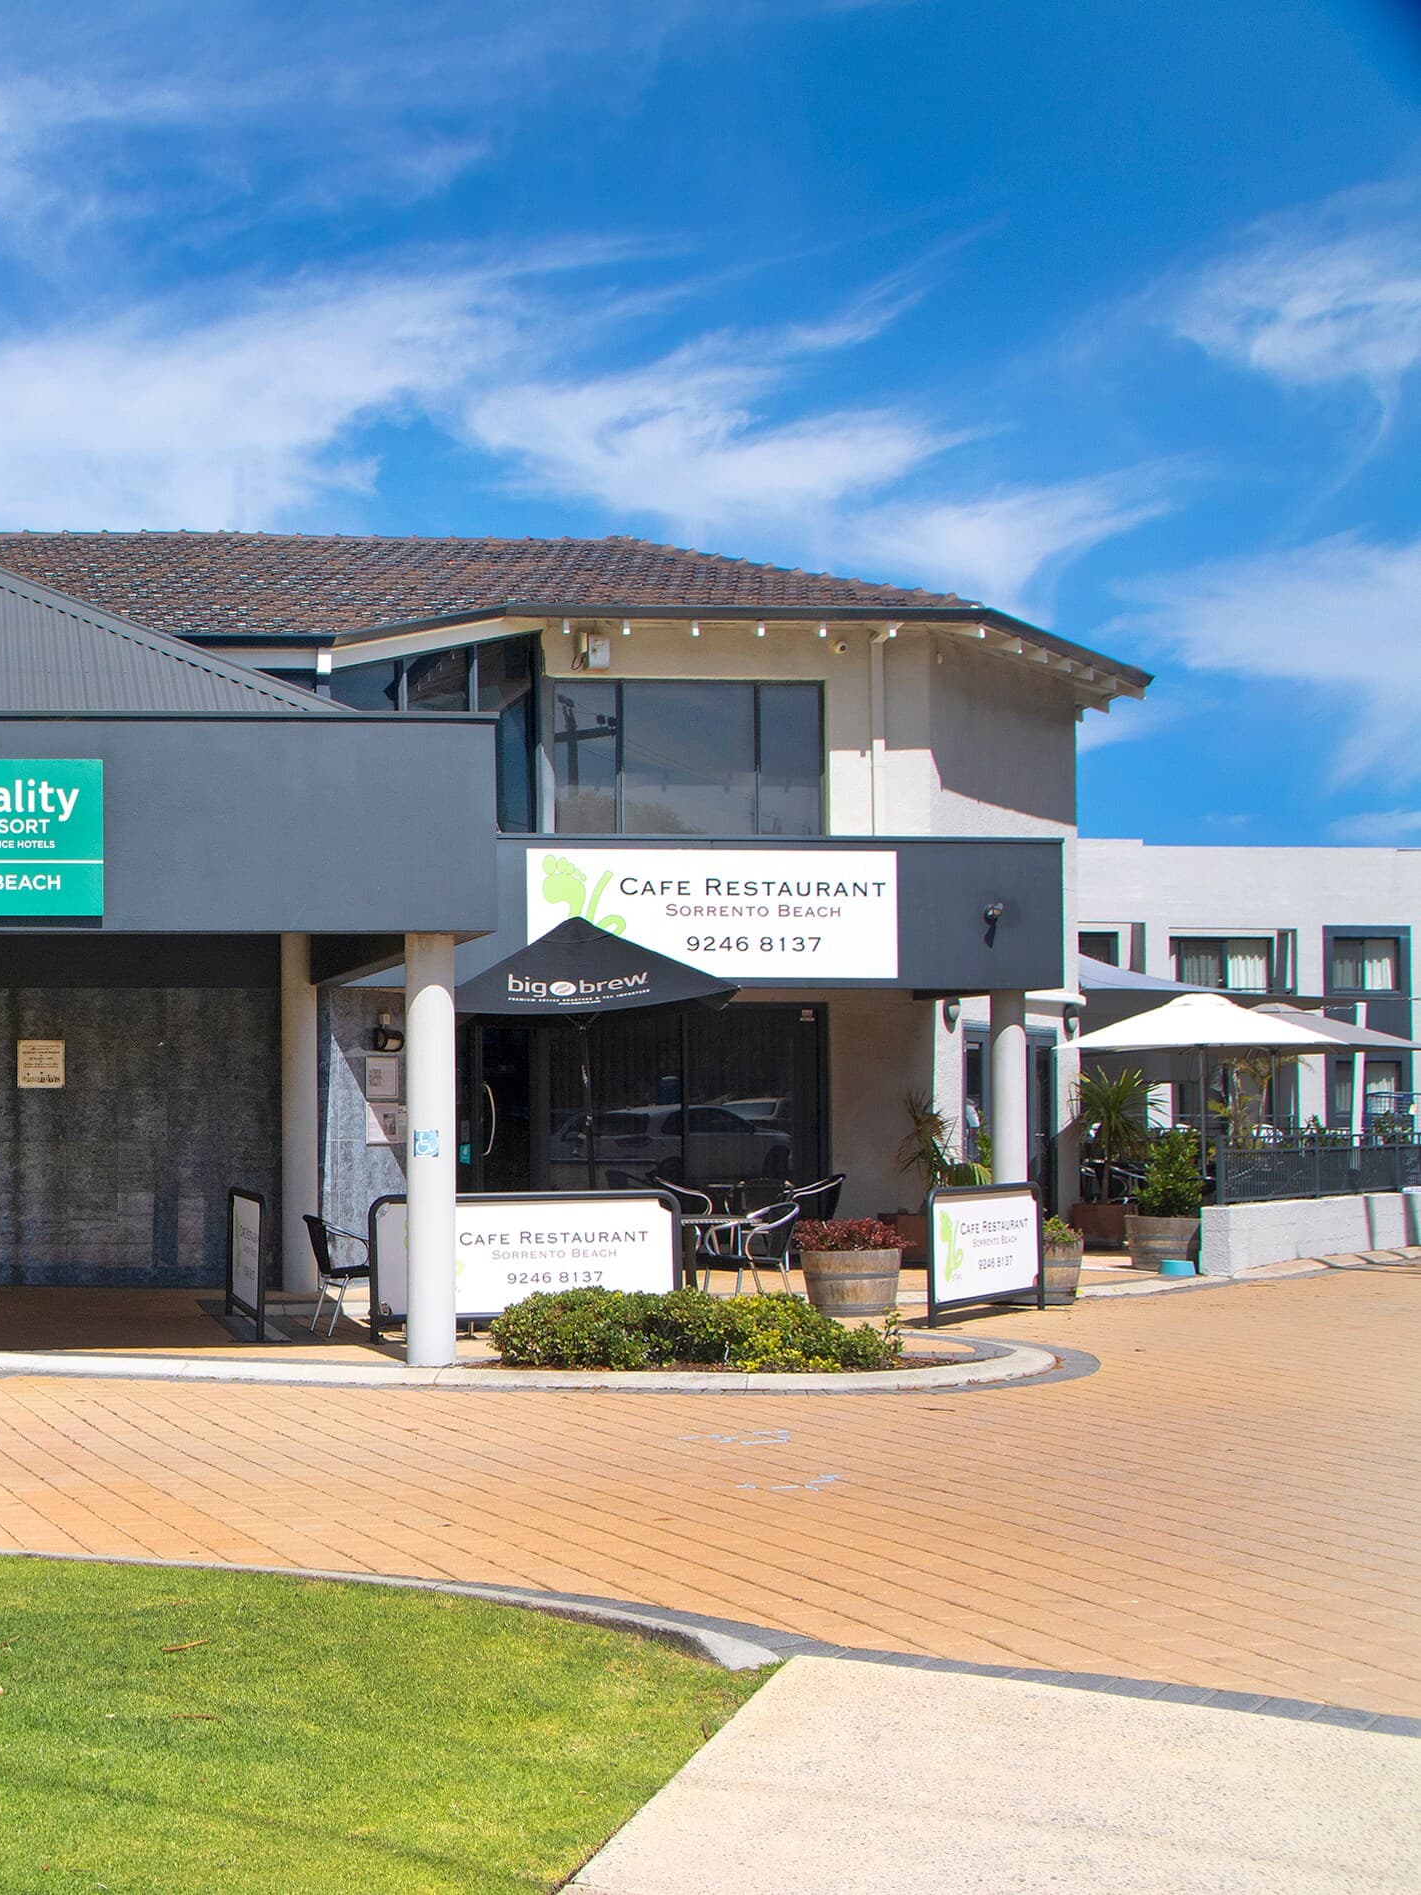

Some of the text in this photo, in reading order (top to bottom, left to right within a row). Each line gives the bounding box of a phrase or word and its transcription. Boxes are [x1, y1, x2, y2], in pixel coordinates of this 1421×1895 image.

[17, 839, 56, 849] HOTELS
[619, 877, 887, 898] CAFE RESTAURANT
[665, 903, 842, 918] SORRENTO BEACH
[686, 936, 822, 953] 9246 8137
[507, 971, 649, 998] big brew
[459, 1230, 649, 1246] CAFE RESTAURANT
[492, 1248, 618, 1260] SORRENTO BEACH
[507, 1271, 604, 1285] 9246 8137
